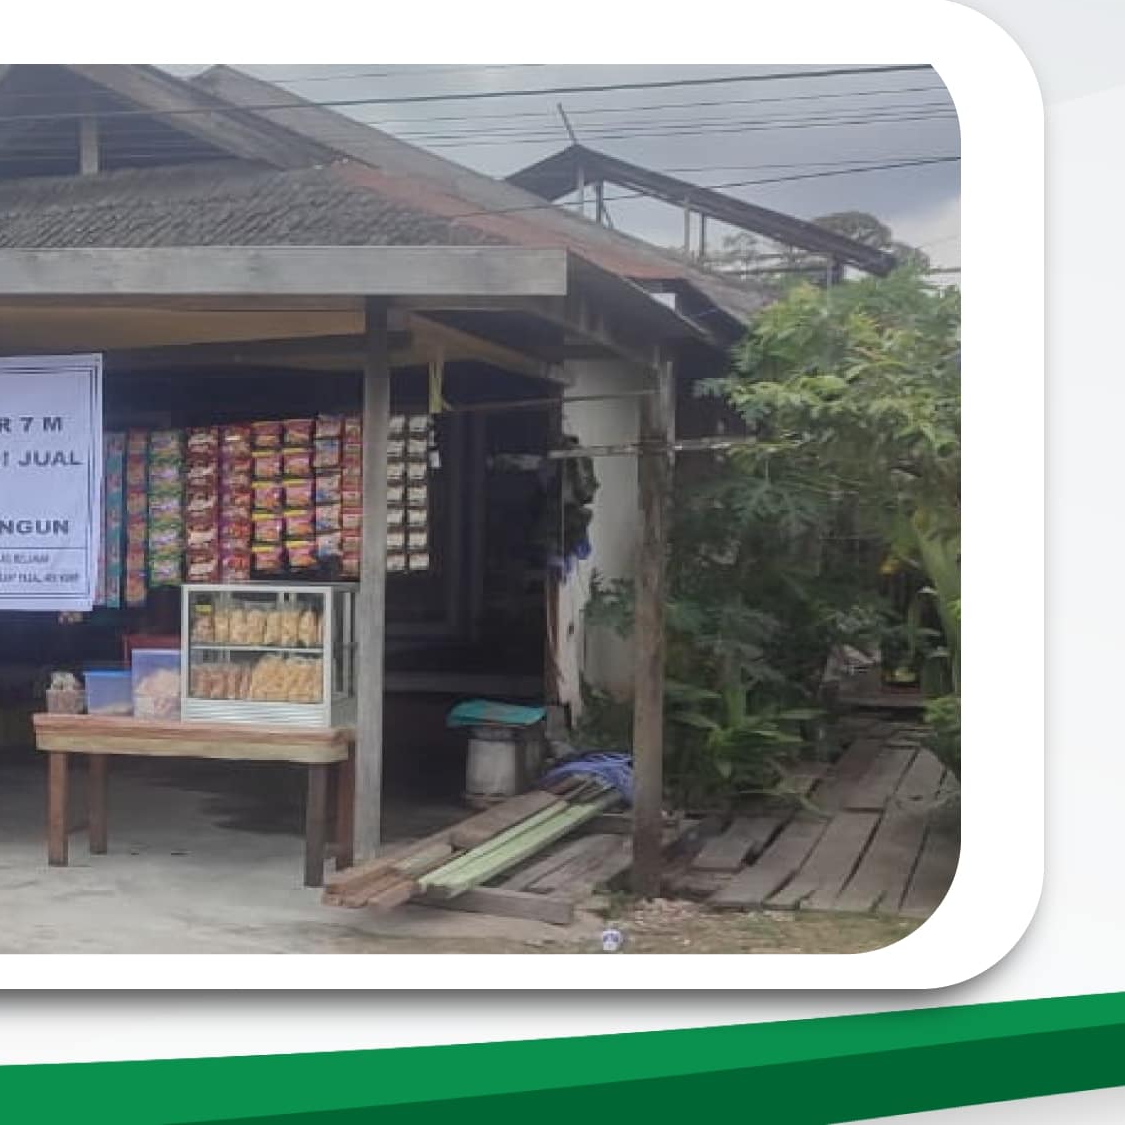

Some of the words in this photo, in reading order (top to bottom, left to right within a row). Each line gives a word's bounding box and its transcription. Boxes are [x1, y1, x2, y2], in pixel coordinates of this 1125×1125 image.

[21, 417, 33, 432] 7
[43, 417, 62, 431] M
[19, 451, 81, 467] JUAL
